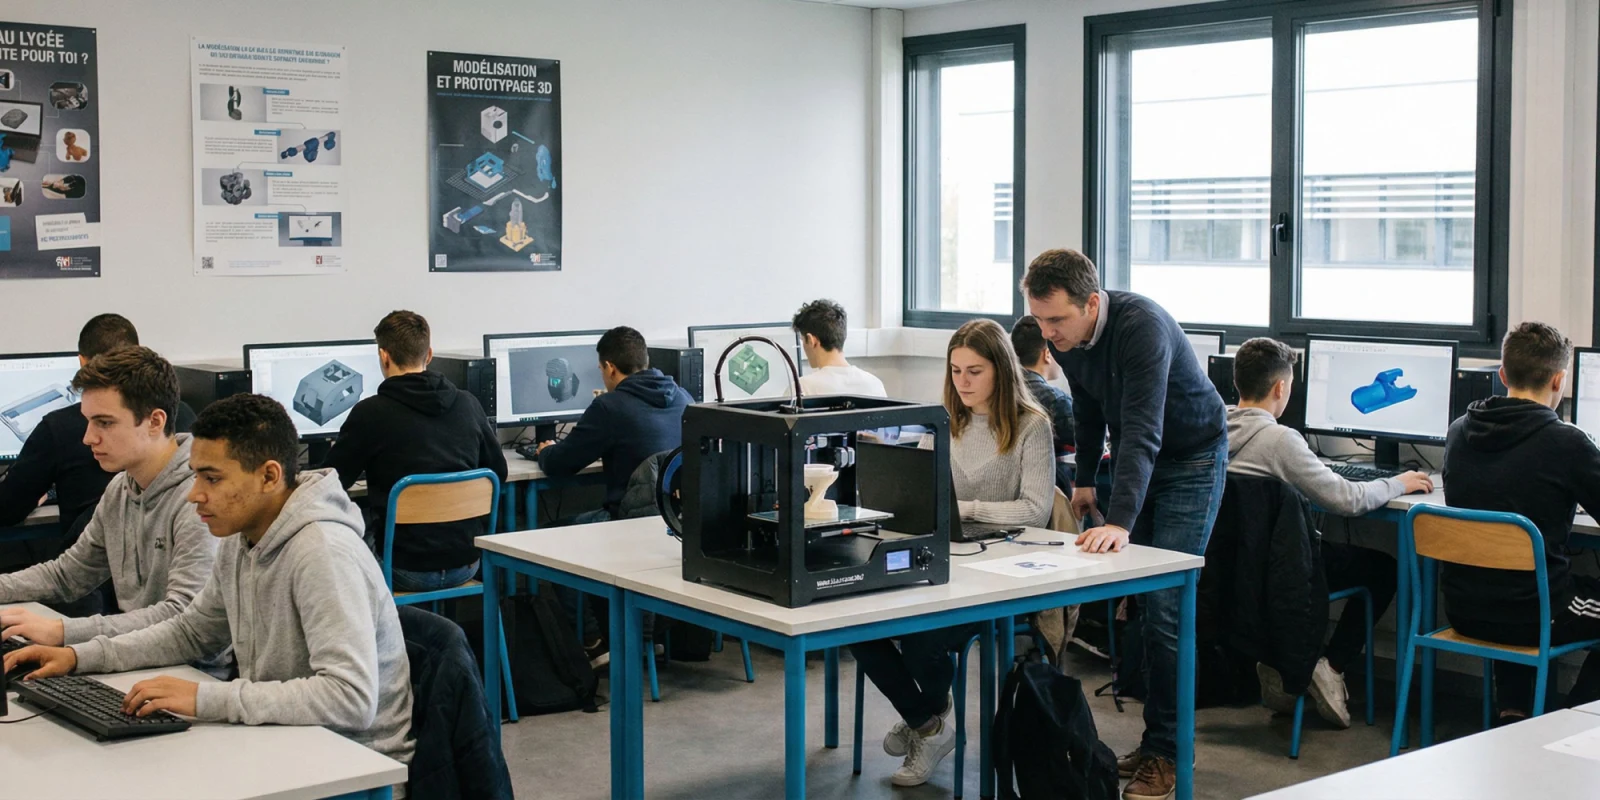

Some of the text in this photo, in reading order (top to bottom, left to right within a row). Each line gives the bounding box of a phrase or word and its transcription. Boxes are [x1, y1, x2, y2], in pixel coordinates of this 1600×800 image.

[19, 30, 64, 47] LYCÉE
[21, 49, 54, 62] POUR
[57, 51, 77, 63] TOI
[81, 52, 88, 64] ?
[453, 59, 537, 77] MODÉLISATION
[436, 75, 552, 93] ET PROTOTYPAGE 3D
